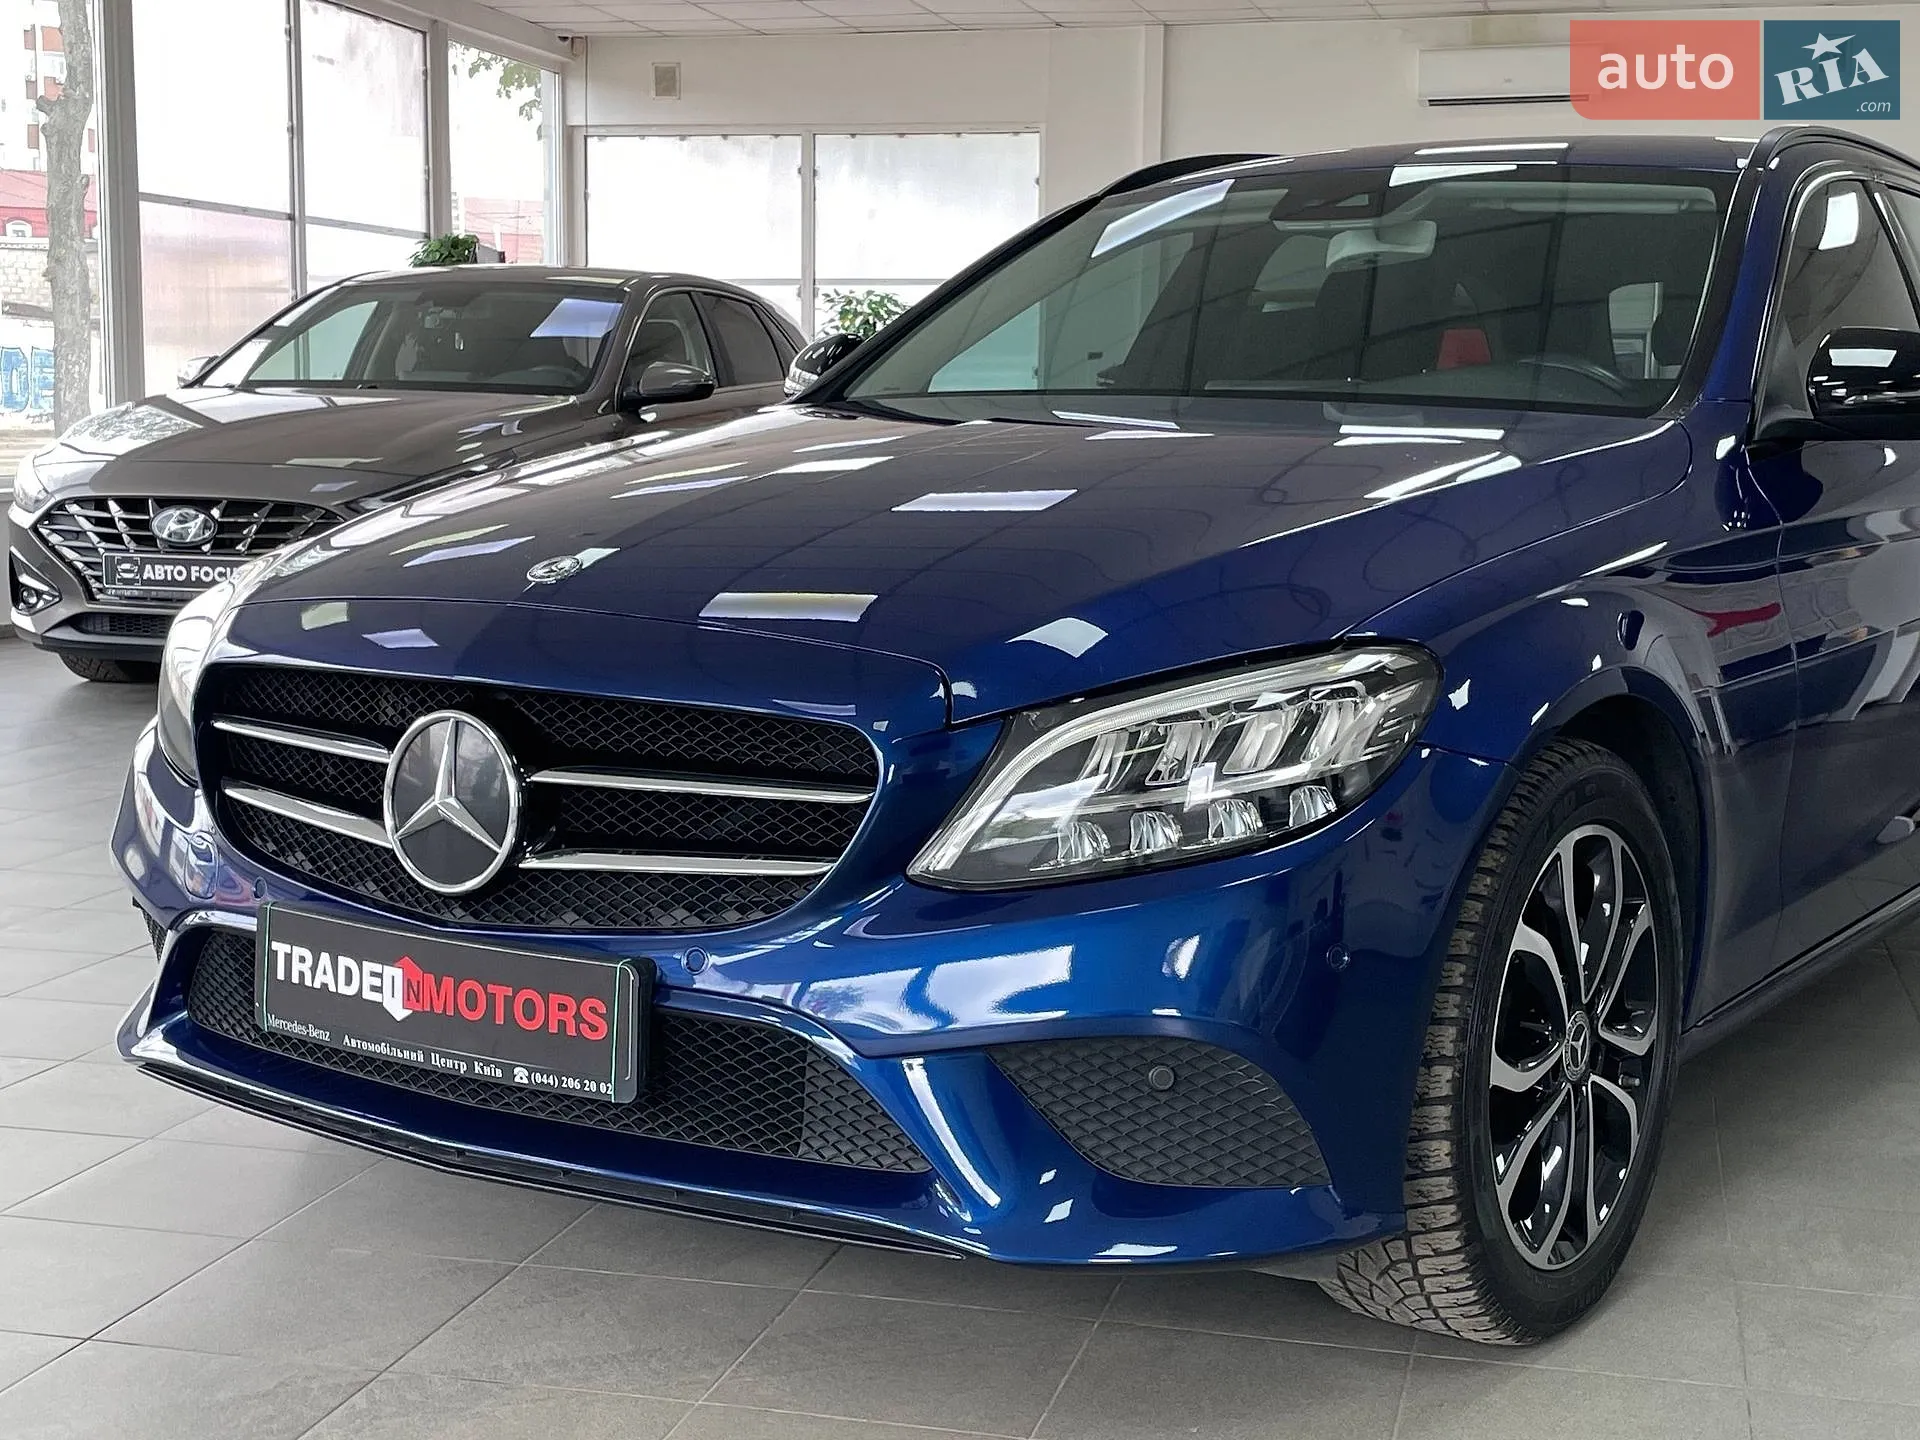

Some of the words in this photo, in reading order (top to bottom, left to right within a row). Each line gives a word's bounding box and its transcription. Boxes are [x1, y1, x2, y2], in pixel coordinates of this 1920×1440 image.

[142, 564, 188, 581] АВТО
[267, 1012, 331, 1041] Mercedes-Benz
[343, 1034, 425, 1063] Автомобільний
[430, 1052, 468, 1074] Центр
[474, 1061, 503, 1079] Київ
[530, 1071, 559, 1089] (044)
[561, 1076, 581, 1090] 206
[583, 1079, 597, 1093] 20
[599, 1082, 613, 1095] 02
